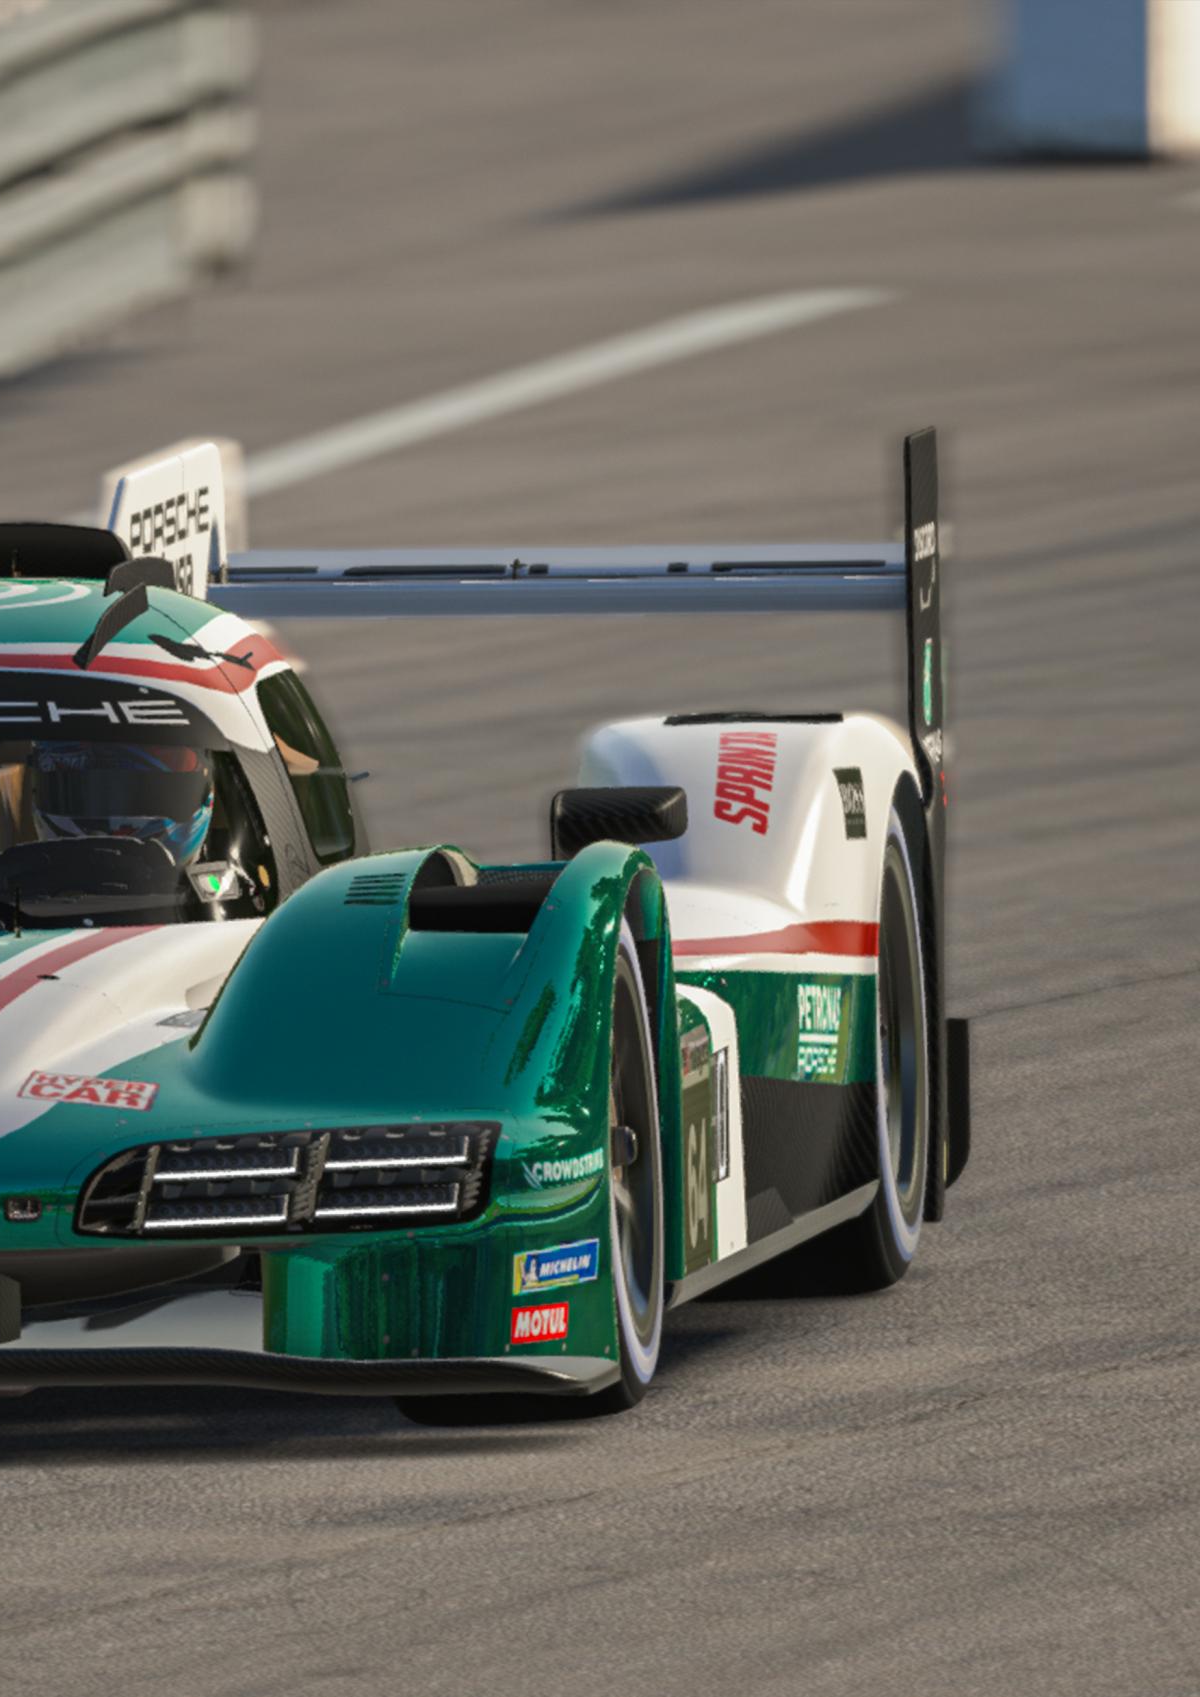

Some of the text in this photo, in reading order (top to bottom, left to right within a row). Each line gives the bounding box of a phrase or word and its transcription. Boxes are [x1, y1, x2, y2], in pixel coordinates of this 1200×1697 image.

[131, 486, 209, 554] PORSCHE
[29, 1083, 142, 1107] CAR
[36, 1074, 146, 1092] HYPER
[687, 1118, 709, 1249] 64
[540, 1253, 591, 1277] MICHELIN
[514, 1307, 566, 1338] MOTUL
